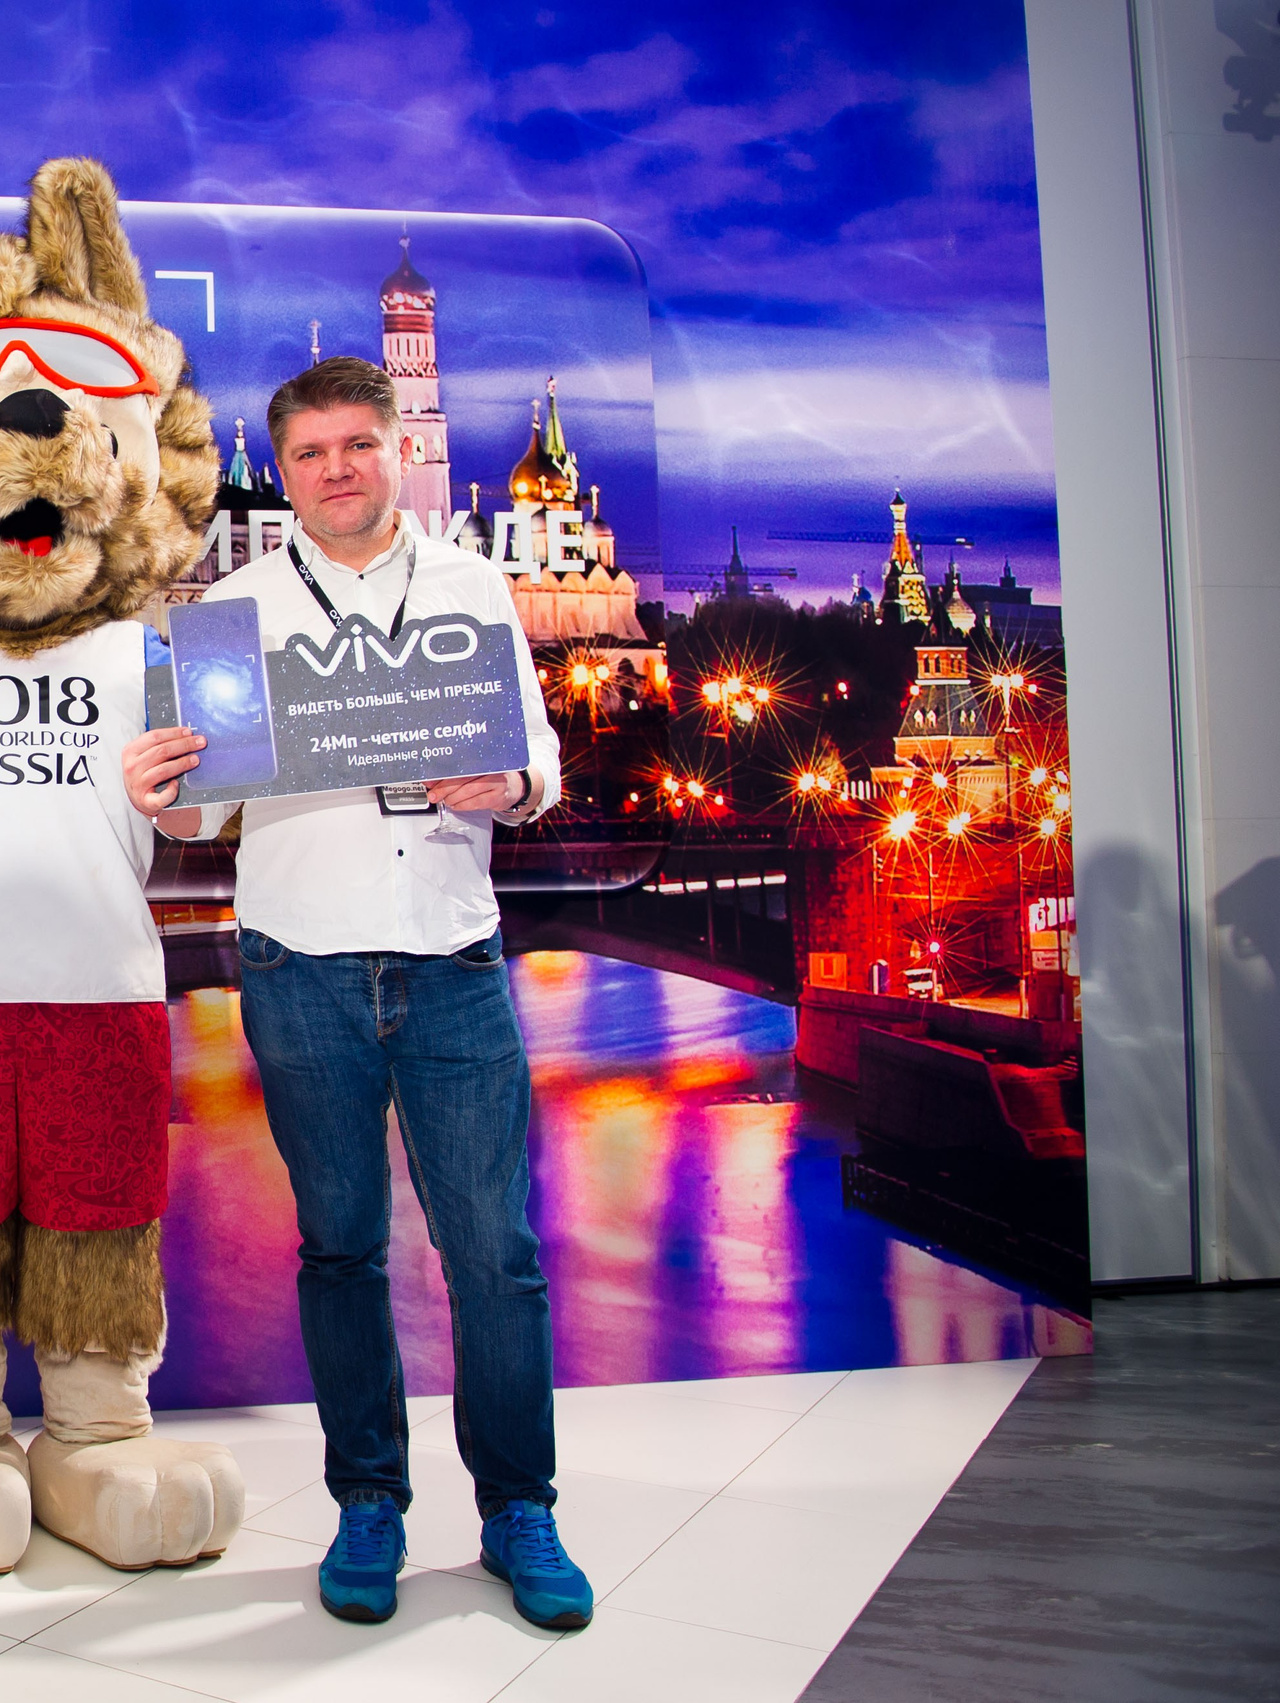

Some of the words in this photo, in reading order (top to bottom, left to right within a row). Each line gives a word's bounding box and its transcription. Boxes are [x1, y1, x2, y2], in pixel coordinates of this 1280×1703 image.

[299, 564, 314, 585] vivo
[295, 623, 478, 677] vivo
[288, 698, 343, 717] ВИДЕТЬ
[346, 691, 408, 710] БОЛЬШЕ,
[410, 687, 441, 702] ЧЕМ
[444, 680, 503, 699] ПРЕЖДЕ
[60, 731, 100, 749] CUP
[310, 734, 358, 753] 24Мп
[434, 720, 487, 739] селфи
[348, 749, 418, 766] Идеальные
[422, 746, 453, 760] фото
